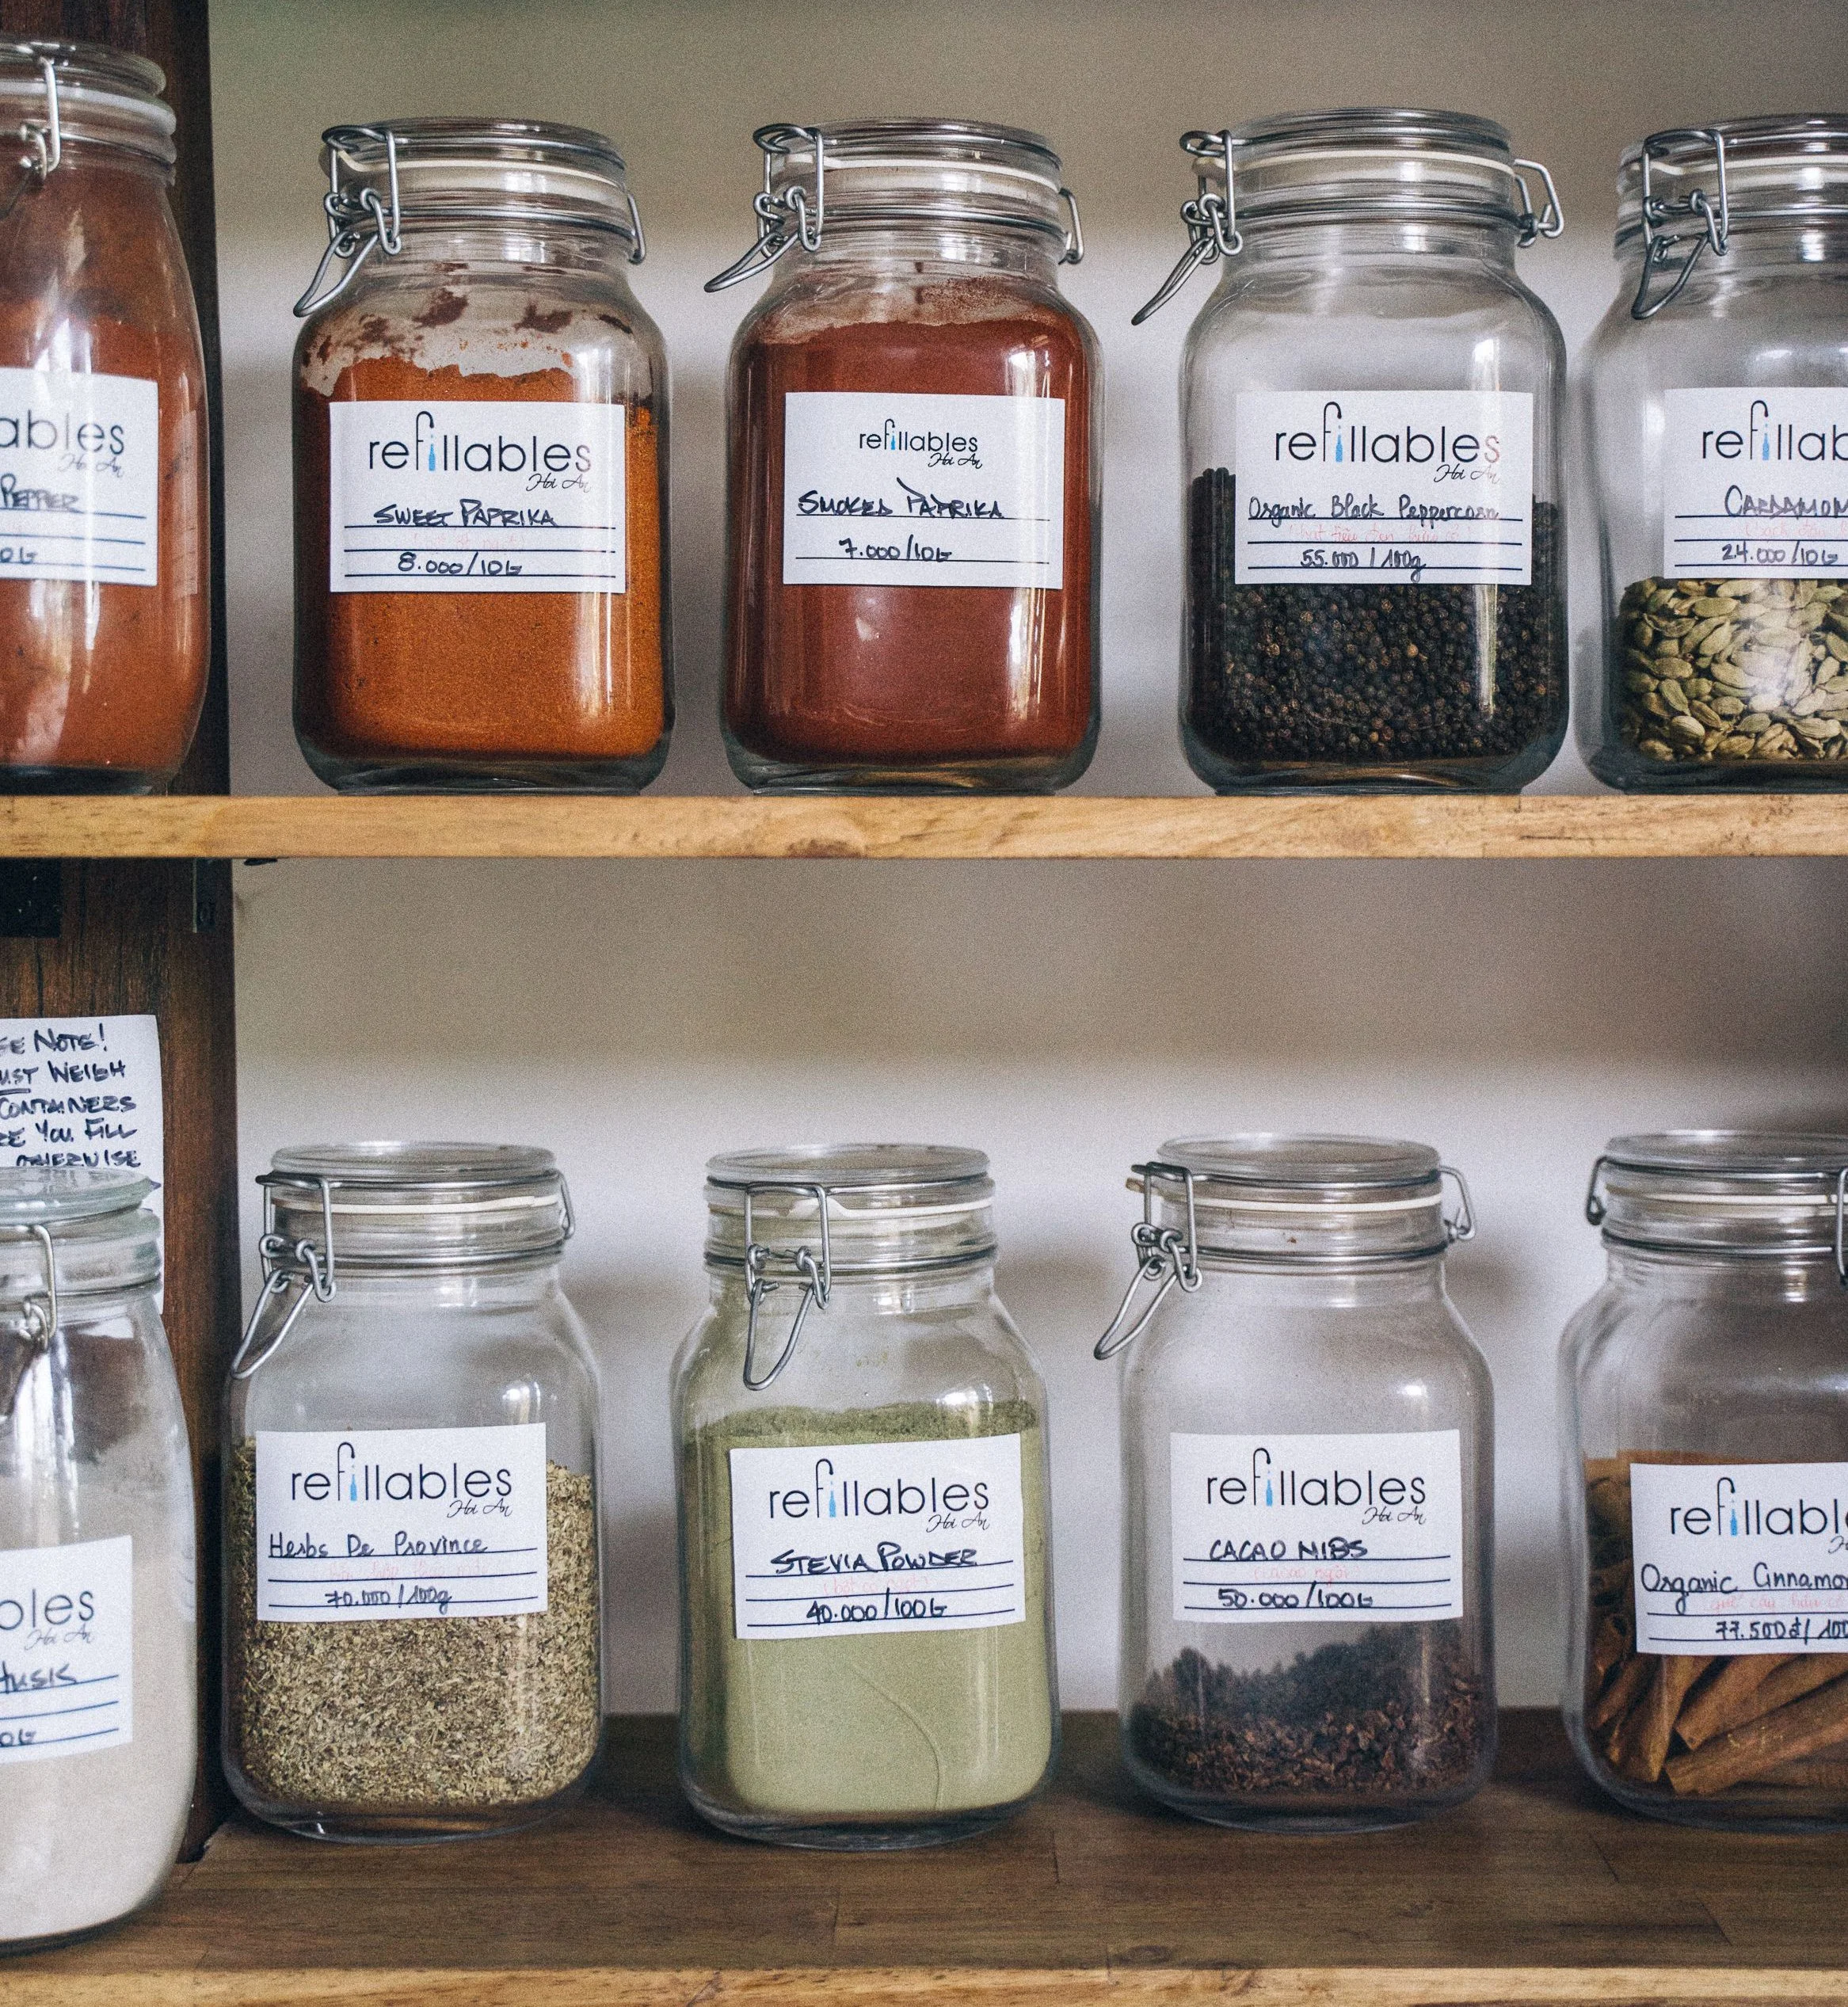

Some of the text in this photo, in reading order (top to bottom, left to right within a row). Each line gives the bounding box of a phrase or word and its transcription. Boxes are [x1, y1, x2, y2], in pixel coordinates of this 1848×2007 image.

[369, 410, 592, 472] refillables
[859, 418, 978, 452] refillables
[1275, 402, 1500, 463] refillables
[57, 452, 86, 473] Ho
[374, 498, 558, 527] SWEET PAPRIKA
[798, 477, 1004, 519] SMOKED PAPRIKA
[1248, 493, 1500, 529] Organic Black Peppercorn
[33, 1023, 108, 1053] NOTE!
[48, 1060, 125, 1083] WEIGH
[84, 1117, 138, 1140] FILL
[291, 1441, 512, 1501] refillables
[769, 1458, 989, 1518] refillables
[1206, 1448, 1426, 1507] refillables
[1671, 1476, 1848, 1536] refillabl
[269, 1530, 488, 1558] Herbs De Province
[770, 1541, 977, 1575] STEVIA POWDER
[1209, 1537, 1368, 1561] CACAO NIBS
[1641, 1563, 1738, 1616] Organic
